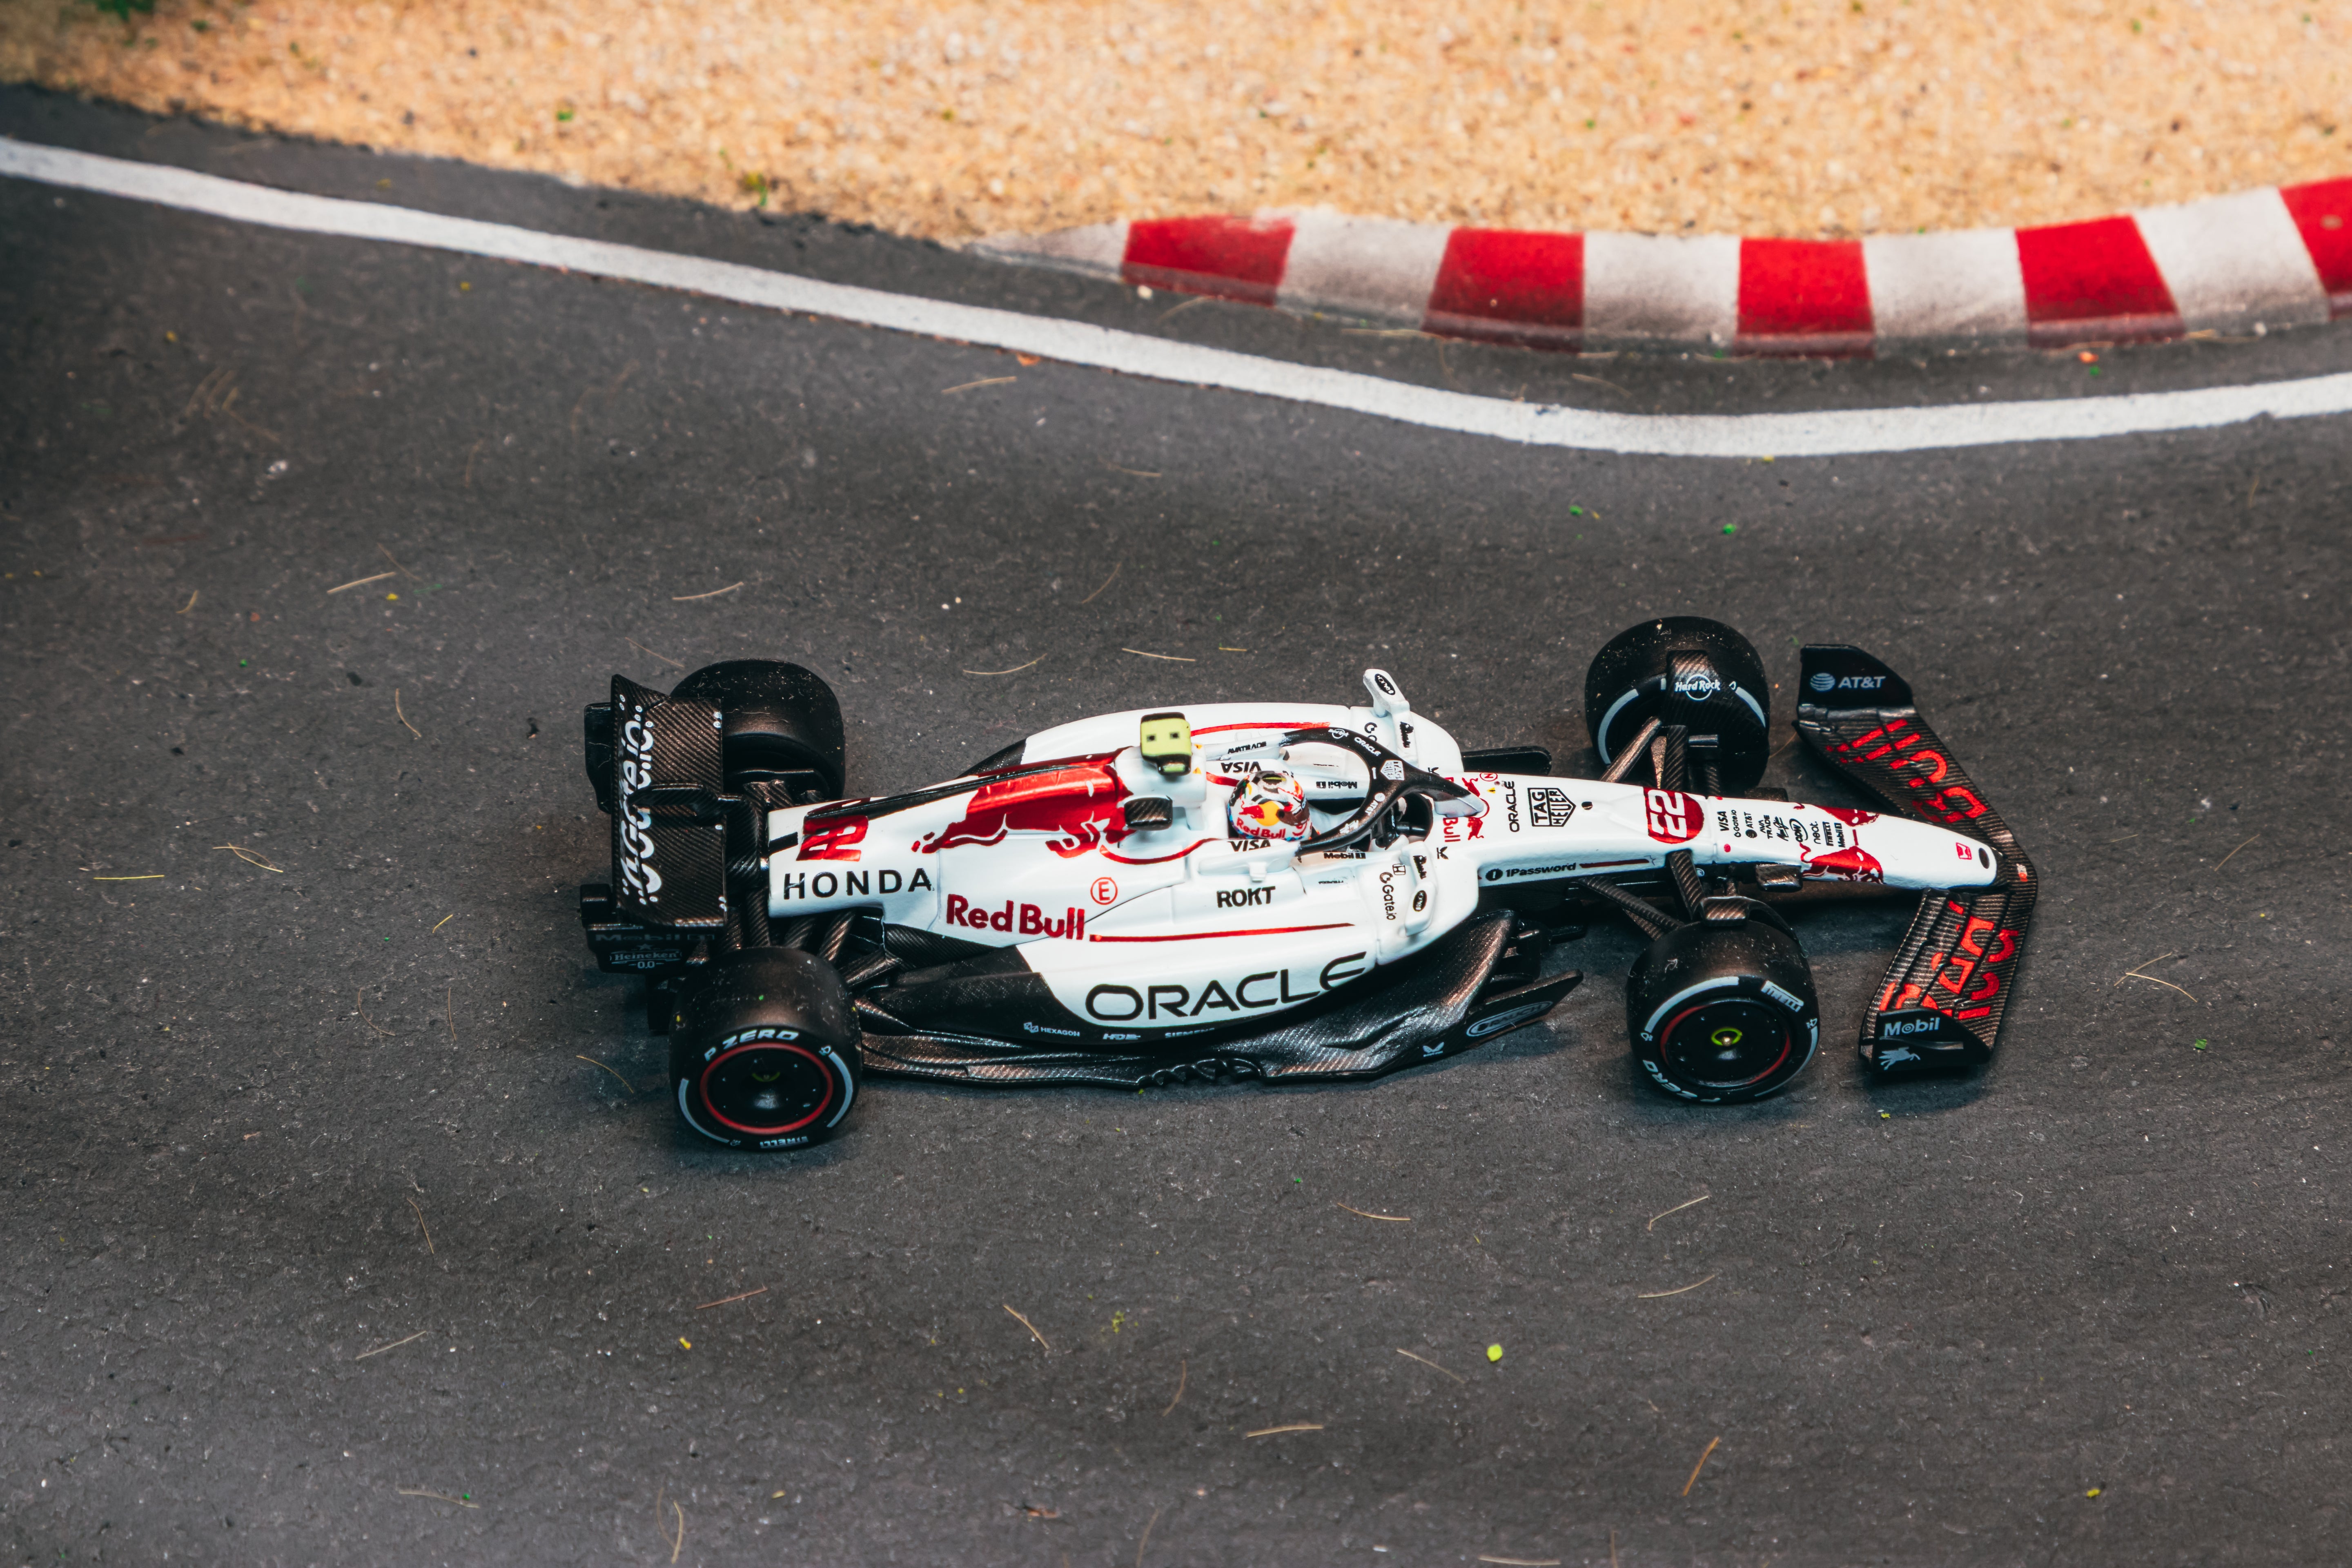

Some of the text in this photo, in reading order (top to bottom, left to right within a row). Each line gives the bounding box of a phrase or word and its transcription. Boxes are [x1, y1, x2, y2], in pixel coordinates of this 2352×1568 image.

[1675, 679, 1721, 693] Hard Rock
[1838, 676, 1886, 689] AT&T
[1354, 737, 1381, 757] ORACLE
[1221, 761, 1262, 774] VISA
[1504, 780, 1520, 833] ORACLE
[1532, 791, 1548, 824] TAG
[1550, 790, 1572, 824] HEUER
[1648, 789, 1687, 838] 22
[1236, 817, 1286, 840] Red Bull
[1443, 817, 1461, 843] Bull
[1717, 811, 1730, 832] VISA
[1731, 809, 1740, 832] Gate.io
[1744, 811, 1753, 829] AT&T
[1764, 815, 1773, 839] TRADE
[1793, 824, 1804, 842] CDW
[1810, 821, 1821, 845] neat.
[1822, 821, 1834, 847] PIRELLI
[1835, 829, 1846, 848] Mobil
[1227, 839, 1271, 852] VISA
[1506, 862, 1576, 877] 1Password
[783, 868, 932, 900] HONDA
[1098, 881, 1111, 901] E
[1216, 886, 1276, 908] ROKT
[1382, 884, 1396, 920] Gate.io
[947, 894, 1085, 940] Red Bull
[614, 952, 677, 961] Heineken
[1085, 951, 1367, 1021] ORACLE
[1040, 1026, 1080, 1037] HEXAGON
[1884, 1017, 1940, 1037] Mobil
[704, 1029, 799, 1061] P ZERO
[1643, 1060, 1698, 1099] ZERO
